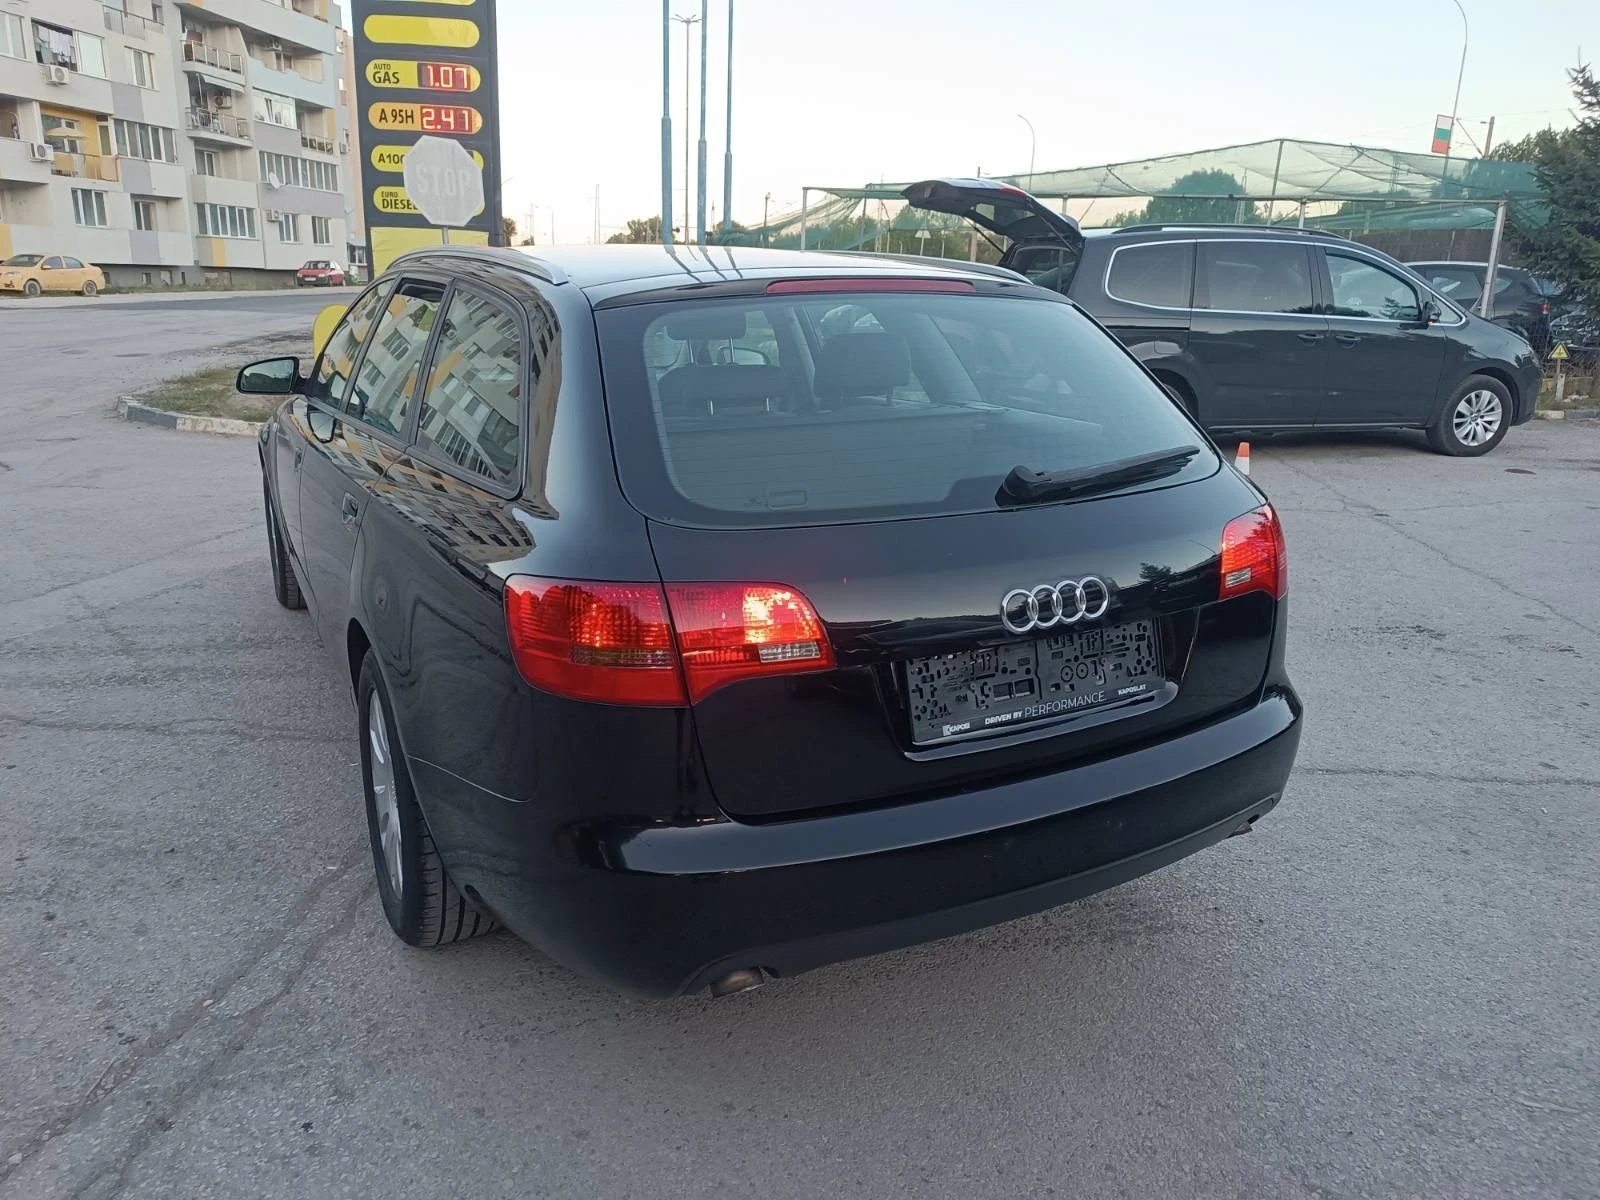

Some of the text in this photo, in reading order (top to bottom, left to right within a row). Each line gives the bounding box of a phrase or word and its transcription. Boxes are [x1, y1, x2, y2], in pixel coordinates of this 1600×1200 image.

[372, 65, 468, 88] GAS 1.07
[379, 108, 469, 130] A 95H 2.41
[416, 164, 470, 198] STOP
[984, 713, 1012, 725] DRIVEN
[1012, 711, 1023, 719] BY
